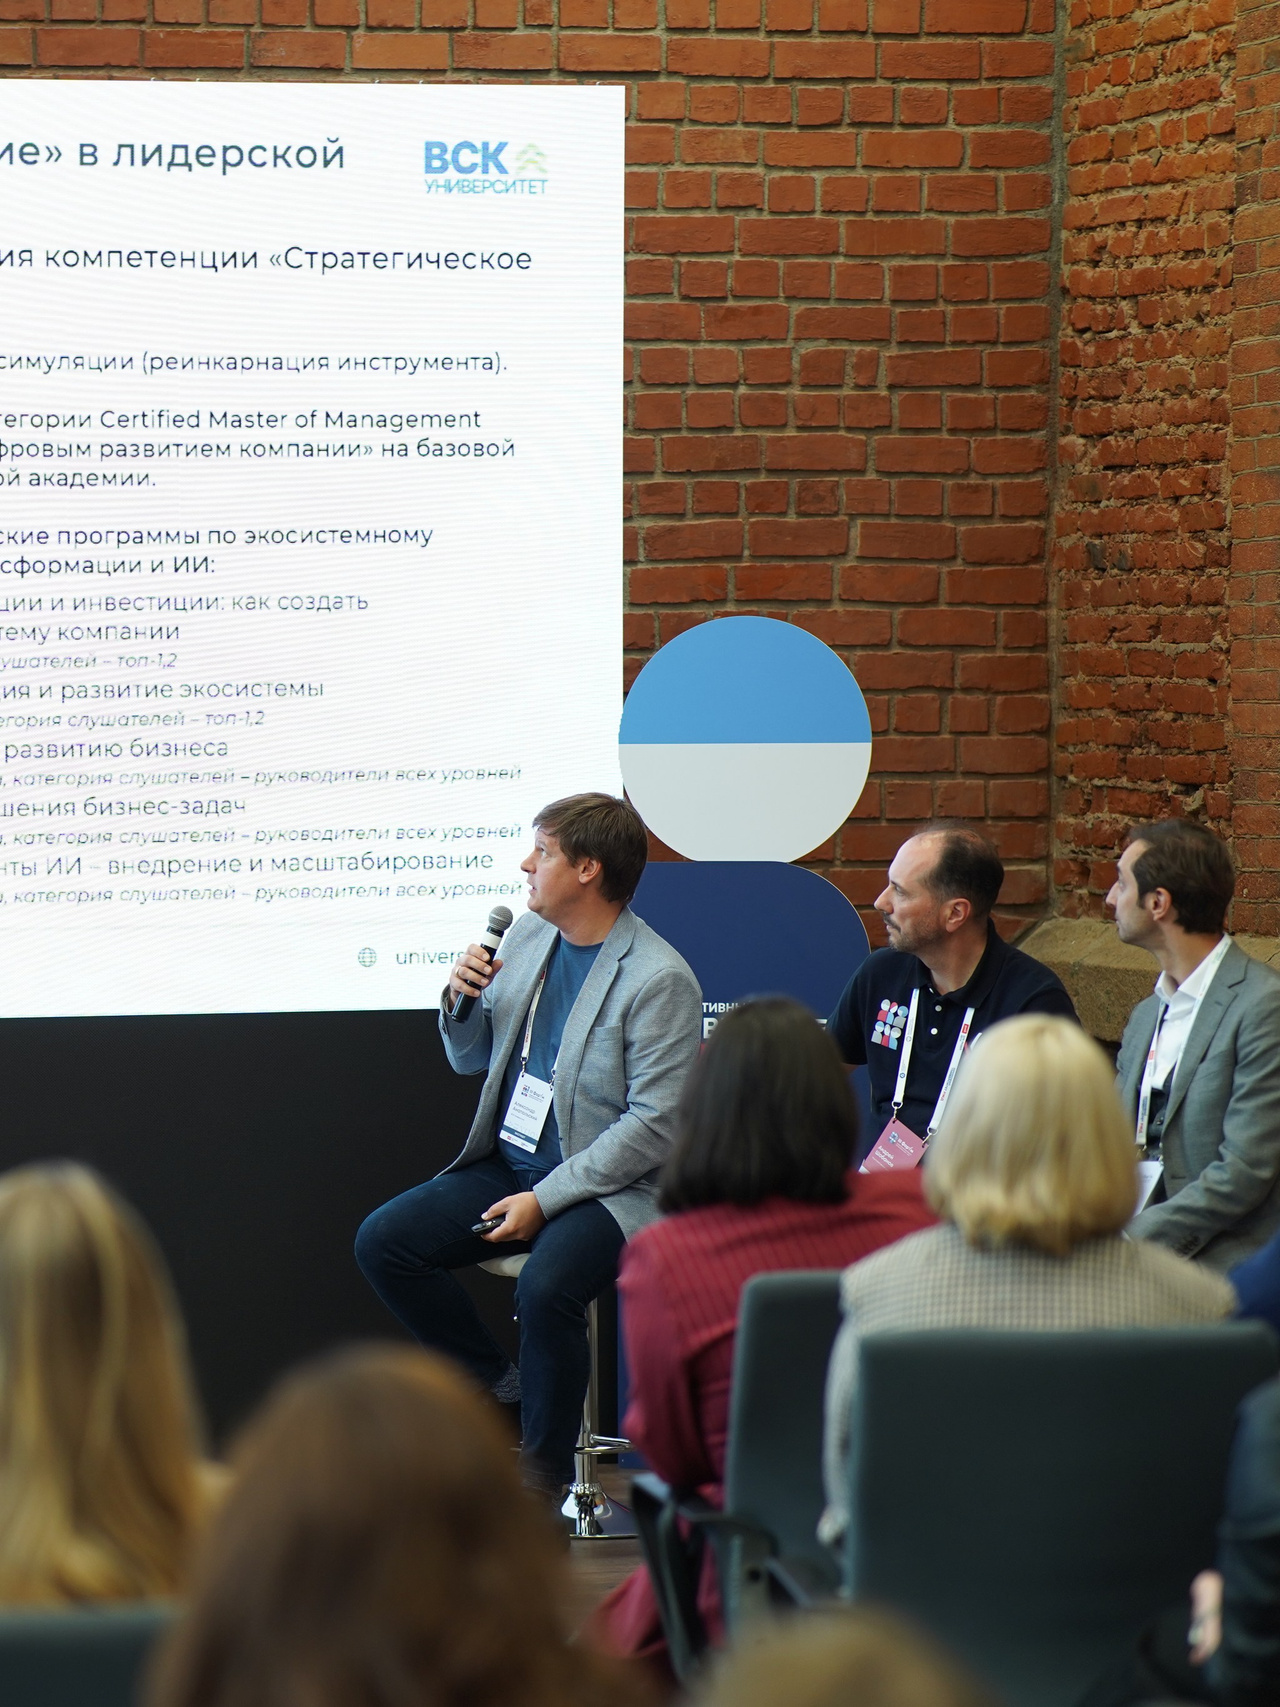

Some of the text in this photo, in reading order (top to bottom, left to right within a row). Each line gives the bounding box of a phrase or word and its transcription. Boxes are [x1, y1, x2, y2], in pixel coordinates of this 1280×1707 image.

[79, 142, 99, 166] в
[112, 133, 344, 178] лидерской
[424, 140, 509, 175] ВСК
[424, 178, 549, 195] УНИВЕРСИТЕТ
[45, 249, 258, 274] компетенции
[269, 245, 532, 276] «Стратегическое
[142, 350, 330, 376] (реинкарнация
[338, 350, 507, 376] инструмента).
[99, 409, 201, 430] Certified
[209, 411, 288, 430] Master
[294, 409, 318, 429] of
[324, 410, 481, 434] Management
[100, 442, 231, 461] развитием
[239, 442, 373, 458] компании»
[381, 442, 409, 458] на
[416, 436, 515, 458] базовой
[28, 472, 156, 490] академии.
[57, 530, 200, 550] программы
[207, 529, 237, 545] по
[244, 529, 434, 549] экосистемному
[150, 560, 164, 574] и
[173, 555, 215, 574] ИИ:
[50, 597, 64, 612] и
[72, 595, 226, 614] инвестиции:
[232, 594, 271, 611] как
[277, 595, 369, 613] создать
[57, 624, 180, 641] компании
[117, 652, 178, 670] топ-1,2
[38, 684, 53, 700] и
[61, 683, 174, 704] развитие
[179, 681, 324, 699] экосистемы
[67, 710, 186, 733] слушателей
[205, 709, 266, 728] топ-1,2
[4, 742, 124, 764] развитию
[129, 736, 228, 758] бизнеса
[12, 772, 113, 790] категория
[119, 770, 236, 790] слушателей
[253, 769, 390, 788] руководители
[395, 768, 437, 782] всех
[440, 768, 522, 784] уровней
[82, 793, 246, 819] бизнес-задач
[13, 831, 113, 848] категория
[119, 829, 236, 848] слушателей
[254, 828, 390, 846] руководители
[395, 827, 437, 840] всех
[440, 825, 522, 843] уровней
[46, 856, 83, 877] ИИ
[108, 858, 243, 879] внедрение
[249, 857, 263, 873] и
[271, 849, 494, 876] масштабирование
[13, 889, 114, 906] категория
[119, 885, 237, 906] слушателей
[254, 884, 391, 904] руководители
[395, 883, 437, 897] всех
[440, 880, 523, 902] уровней
[395, 948, 465, 964] univer
